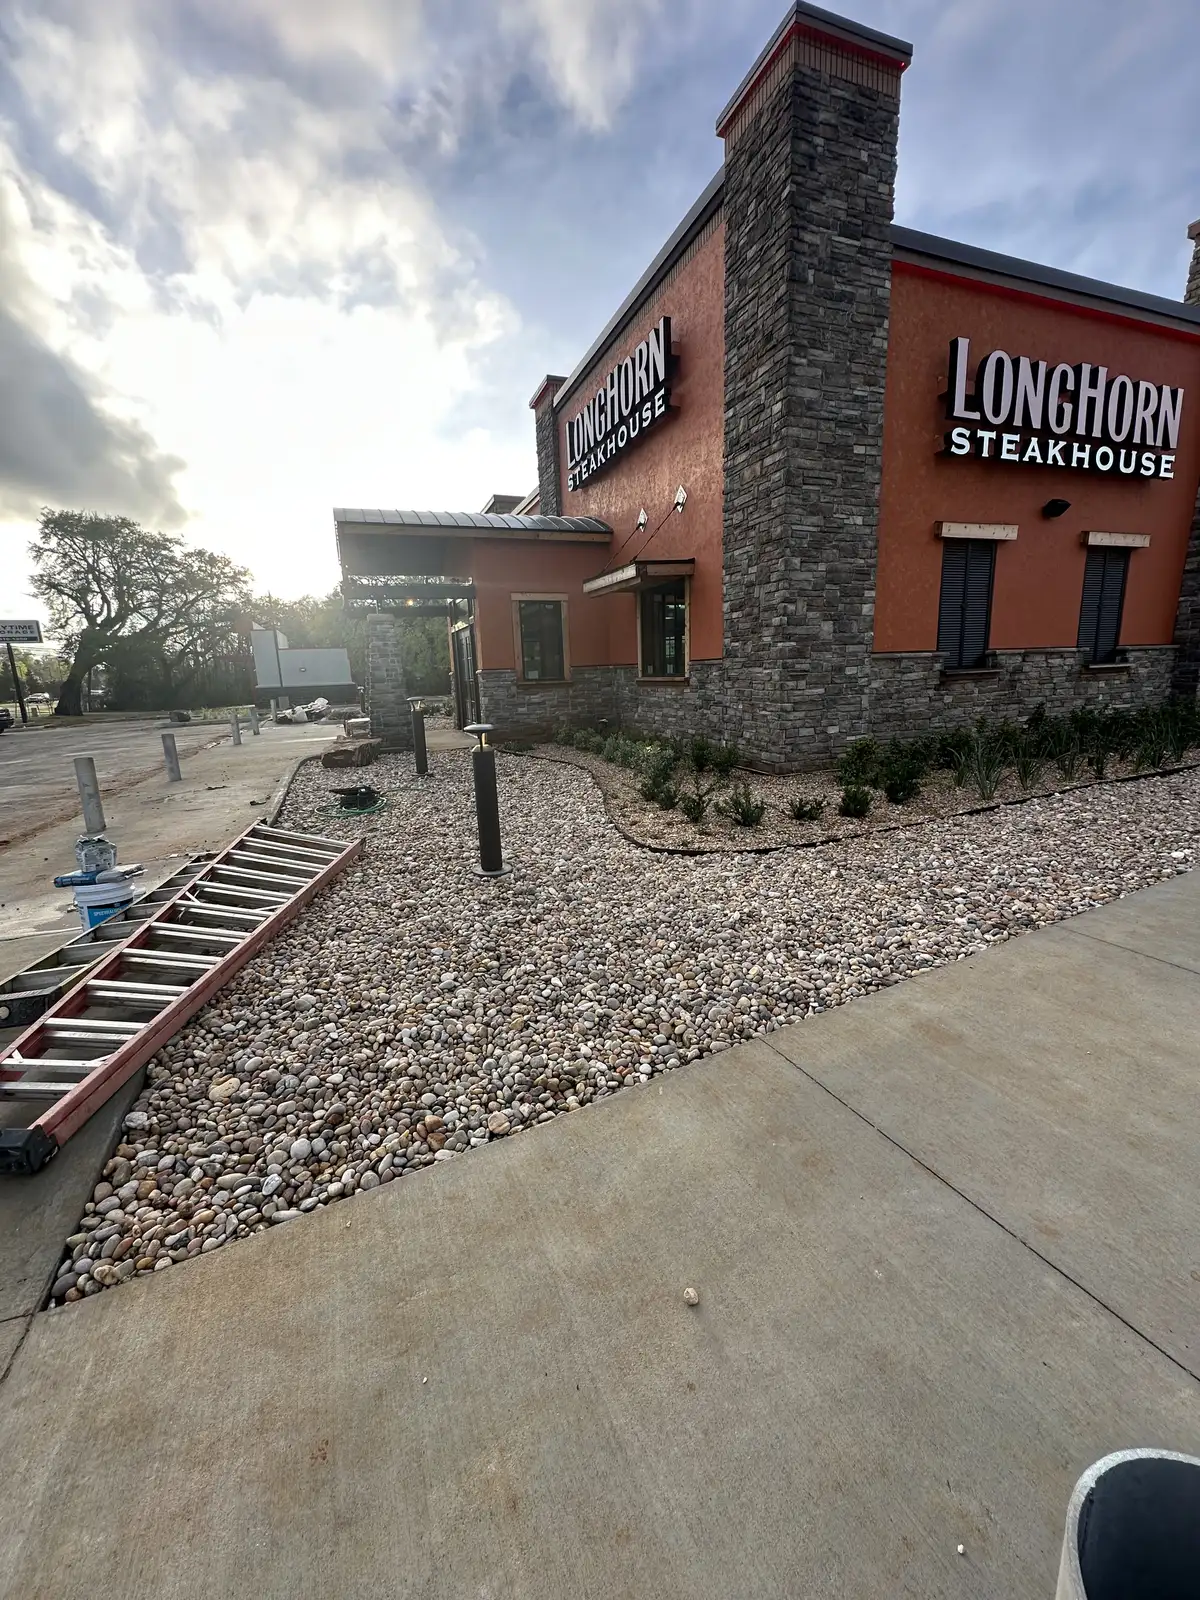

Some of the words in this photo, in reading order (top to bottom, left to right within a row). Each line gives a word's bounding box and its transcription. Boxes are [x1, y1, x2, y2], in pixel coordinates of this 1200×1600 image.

[565, 316, 666, 470] LONGHORN
[567, 387, 666, 492] STEAKHOUSE
[953, 337, 1184, 449] LONGHORN
[950, 426, 1176, 479] STEAKHOUSE
